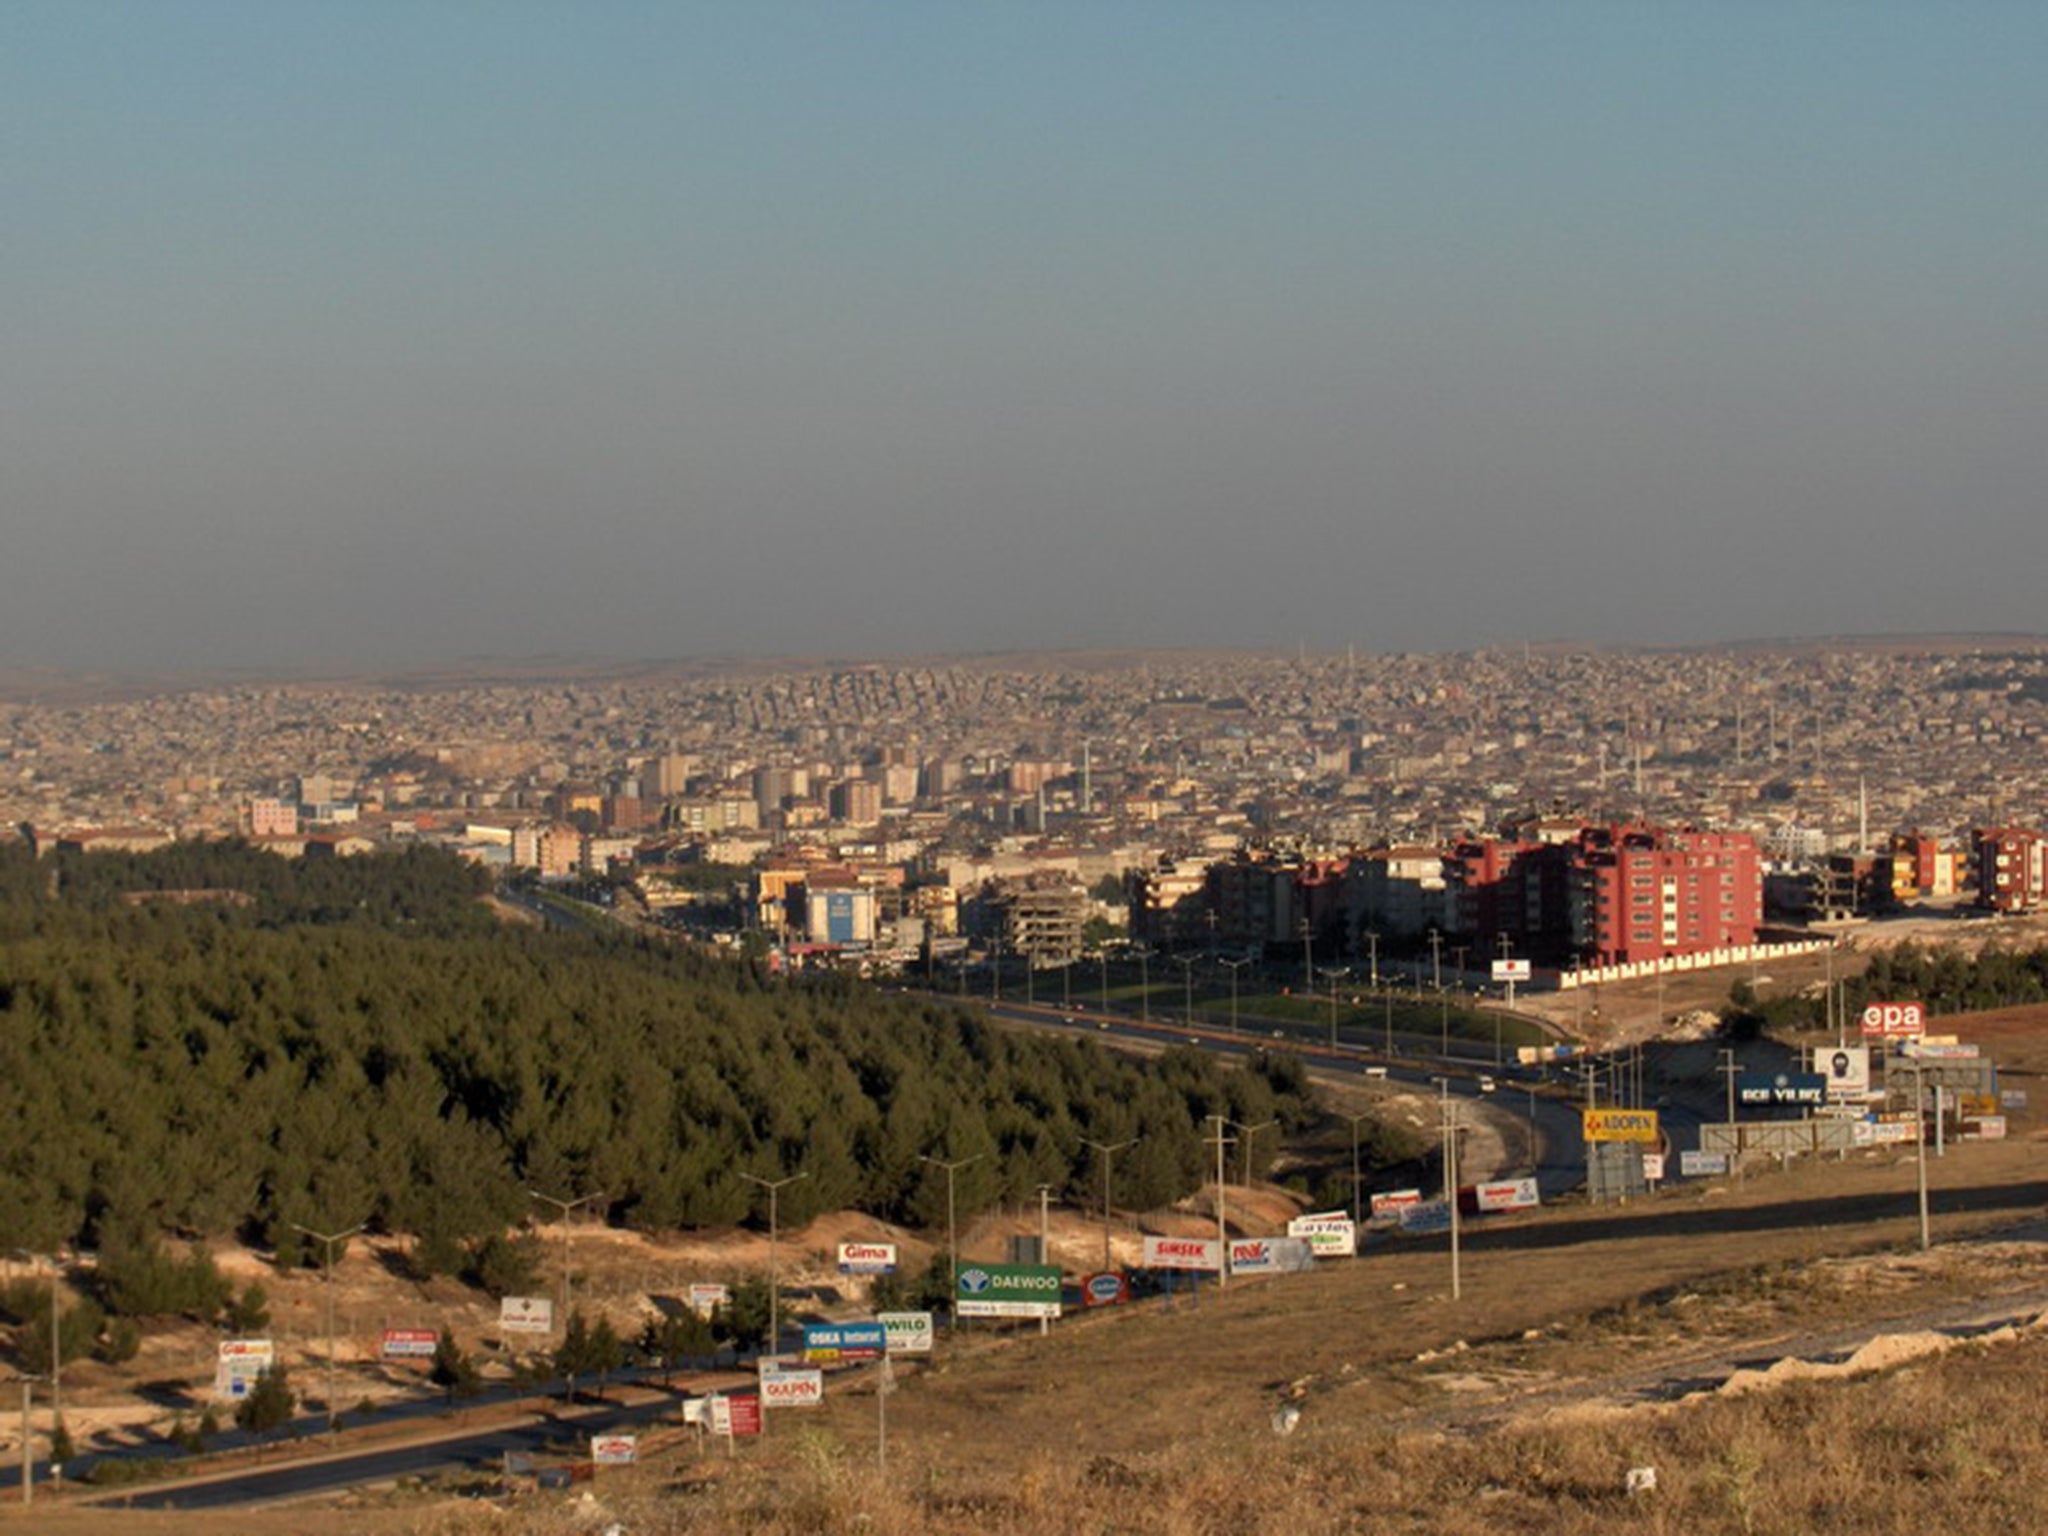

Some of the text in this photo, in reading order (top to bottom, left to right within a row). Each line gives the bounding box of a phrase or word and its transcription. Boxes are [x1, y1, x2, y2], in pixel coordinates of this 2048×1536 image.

[1864, 1006, 1920, 1031] epa
[845, 1245, 887, 1258] Gima
[992, 1275, 1058, 1289] DAEWOO
[885, 1320, 925, 1331] WILO
